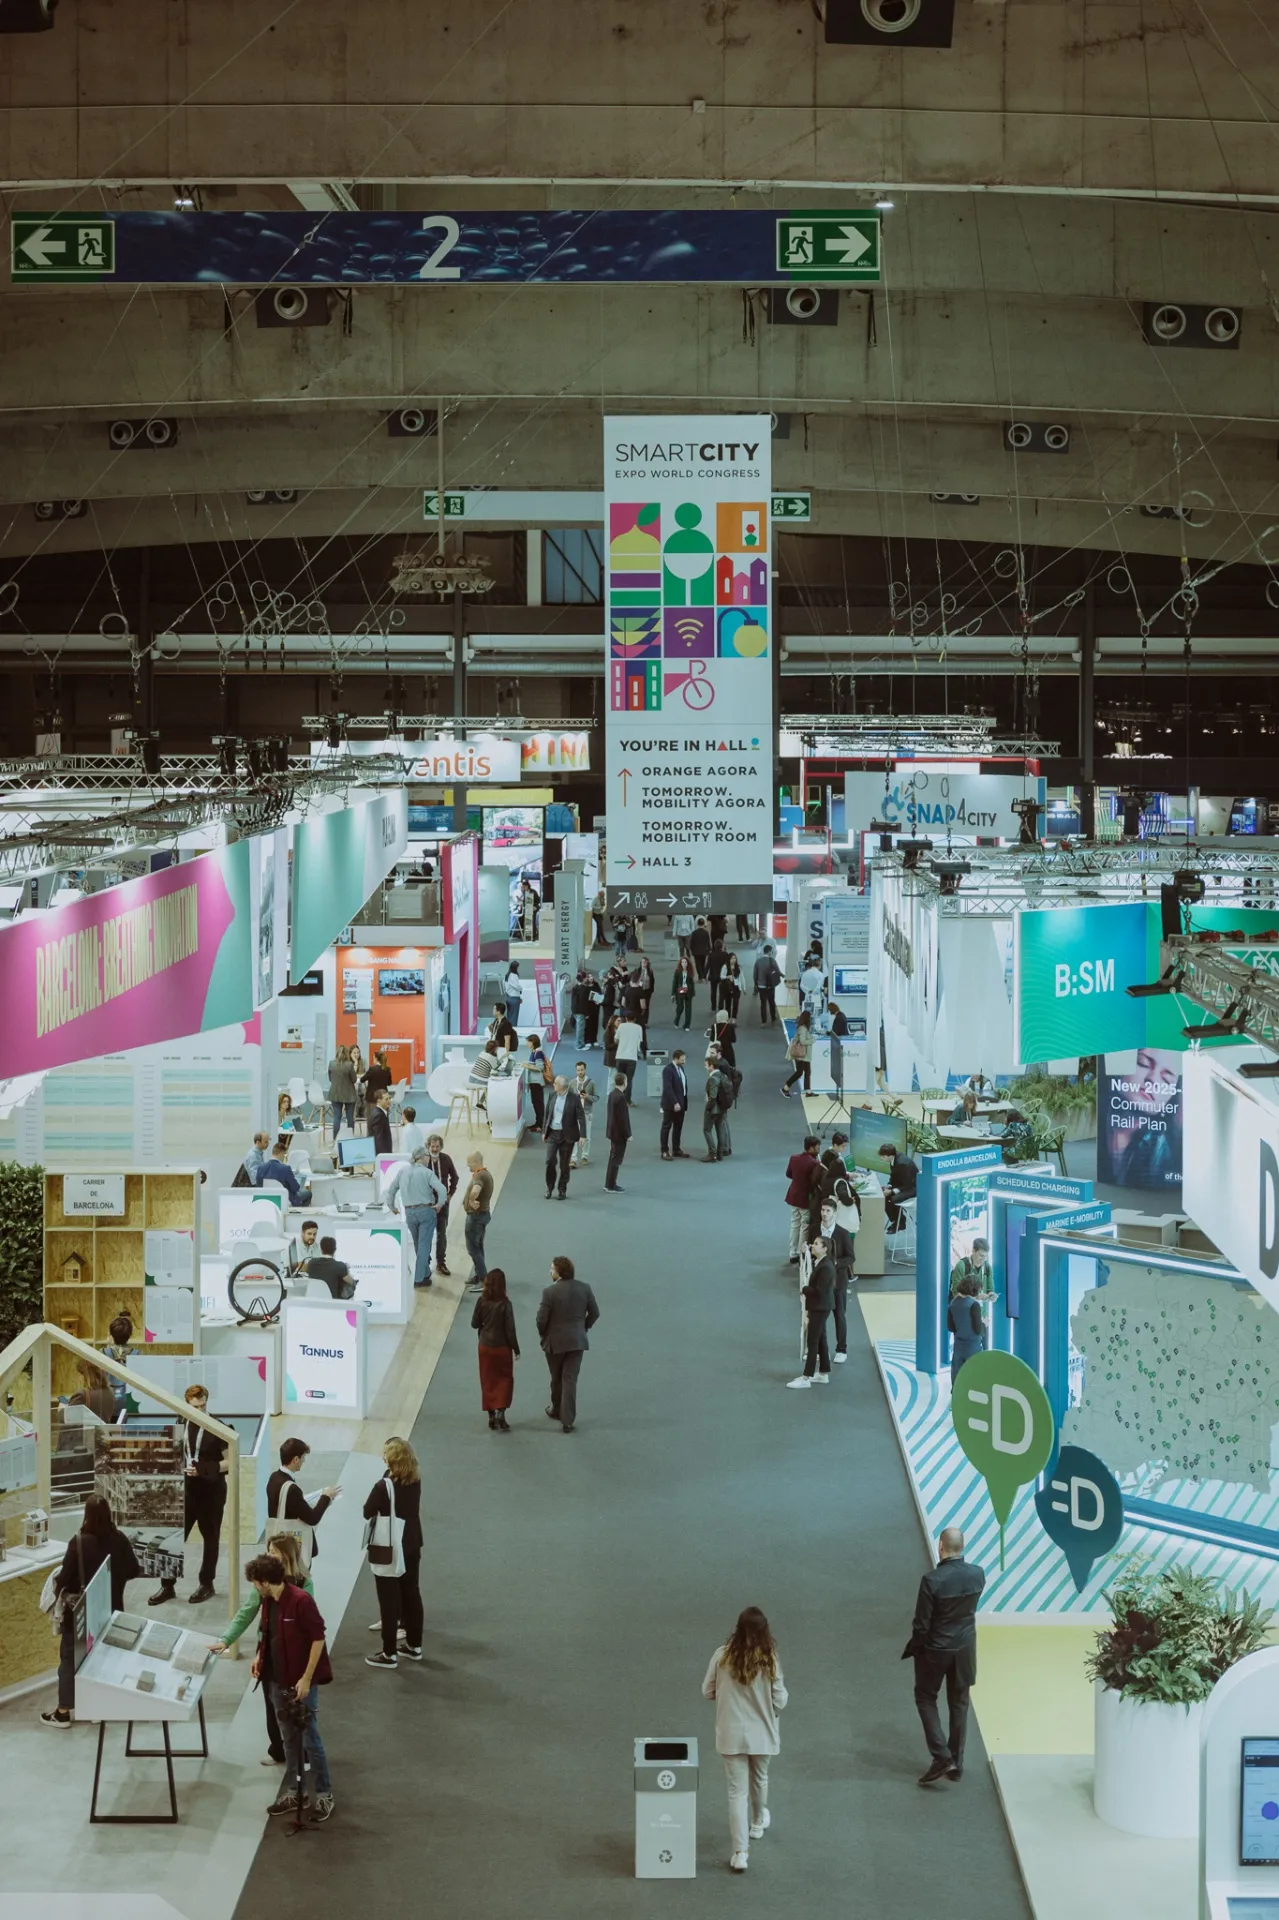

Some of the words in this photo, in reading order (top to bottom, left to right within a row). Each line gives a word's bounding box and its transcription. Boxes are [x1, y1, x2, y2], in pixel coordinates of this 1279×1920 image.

[419, 215, 462, 279] 2
[615, 442, 760, 462] SMARTCITY
[615, 469, 646, 479] EXPO
[650, 469, 694, 478] WORLD
[697, 469, 760, 478] CONGRESS
[619, 739, 680, 752] YOU'RE
[684, 739, 701, 752] IN
[641, 766, 702, 776] ORANGE
[707, 766, 758, 776] AGORA
[641, 787, 732, 797] TOMORROW.
[641, 799, 710, 809] MOBILITY
[715, 798, 766, 808] AGORA
[641, 821, 733, 831] TOMORROW.
[641, 833, 710, 843] MOBILITY
[715, 832, 757, 842] ROOM
[641, 857, 679, 867] HALL
[684, 857, 692, 867] 3
[560, 900, 570, 933] ENERGY
[560, 936, 570, 966] SMART
[1055, 958, 1115, 998] B:SM
[1110, 1078, 1141, 1092] New
[1110, 1096, 1179, 1114] Commuter
[1110, 1114, 1135, 1129] Rail
[1138, 1116, 1167, 1131] Plan
[937, 1157, 964, 1169] ENDOLLA
[963, 1152, 997, 1165] BARCELONA
[1165, 1172, 1173, 1180] of
[996, 1176, 1041, 1190] SCHEDULED
[1041, 1182, 1081, 1196] CHARGING
[73, 1201, 114, 1210] BARCELONA
[1045, 1217, 1070, 1229] MARINE
[1069, 1210, 1104, 1225] E-MOBILITY
